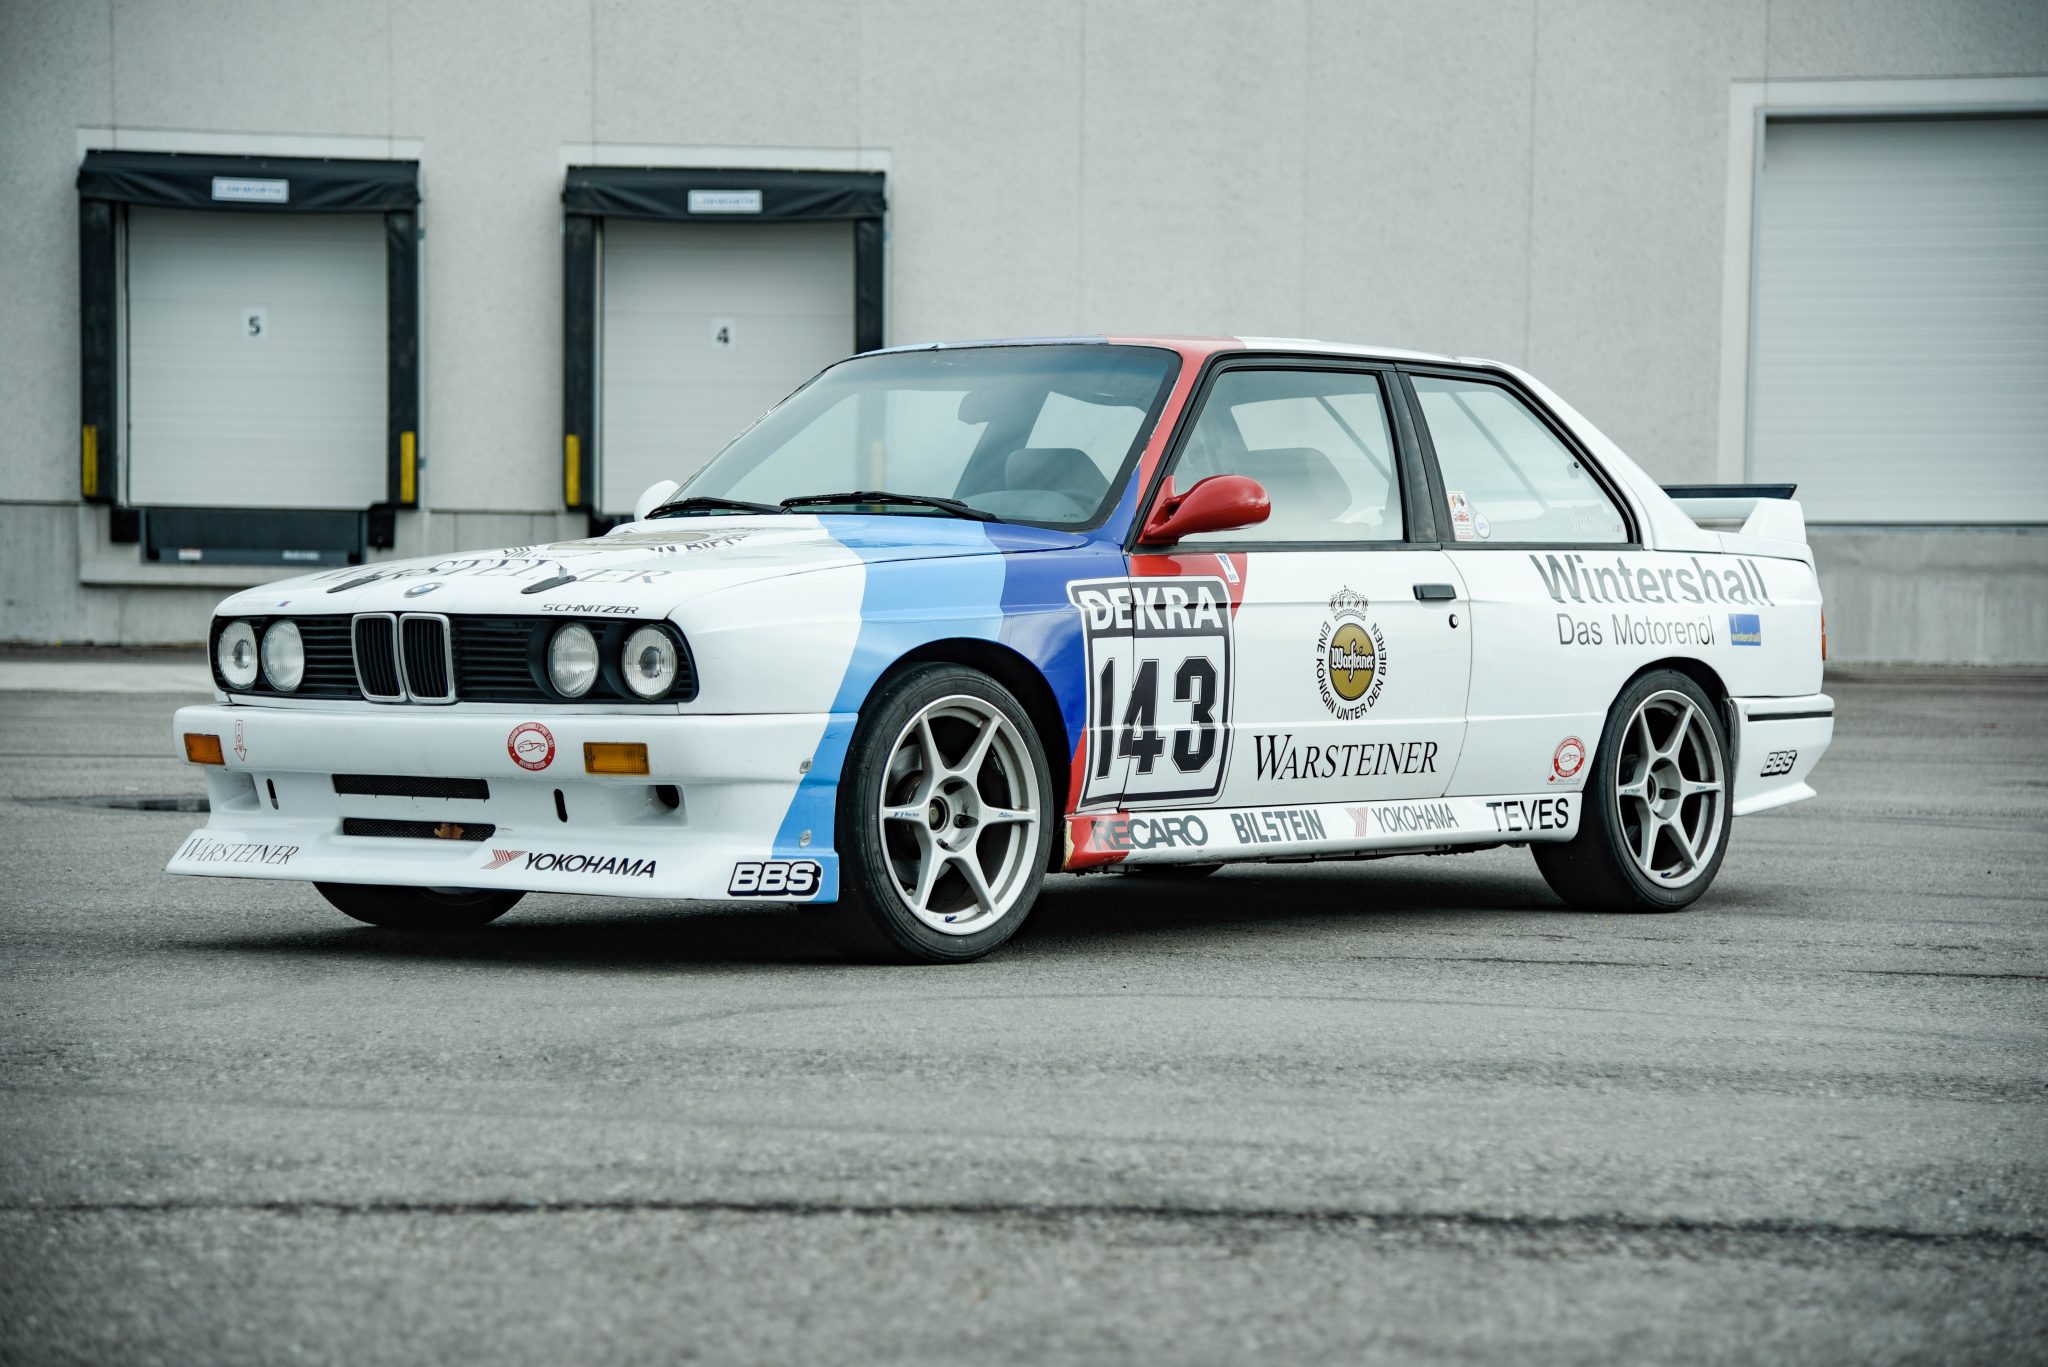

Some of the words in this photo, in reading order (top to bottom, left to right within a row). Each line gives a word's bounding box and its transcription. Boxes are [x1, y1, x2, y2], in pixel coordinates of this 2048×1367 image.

[248, 315, 261, 337] 5
[717, 326, 730, 345] 4
[1528, 554, 1775, 607] Wintershall
[541, 603, 640, 615] SCHNITZER
[1078, 586, 1223, 631] DEKRA
[1317, 620, 1332, 655] EINE
[1557, 613, 1603, 646] Das
[1612, 613, 1716, 646] Motorenöl
[1371, 622, 1387, 676] BIEREN
[1316, 658, 1337, 714] KÖNIGIN
[1366, 678, 1384, 708] DEN
[1094, 655, 1219, 780] 143
[1336, 702, 1368, 721] UNTER
[1253, 734, 1438, 782] WARSTEINER
[1760, 749, 1798, 777] BBS
[1092, 813, 1209, 851] RECARO
[1229, 809, 1328, 845] BILSTEIN
[1372, 802, 1460, 834] YOKOHAMA
[1486, 797, 1569, 833] TEVES
[180, 838, 300, 865] WARSTEINER
[524, 852, 658, 879] YOKOHAMA
[727, 860, 821, 897] BBS
